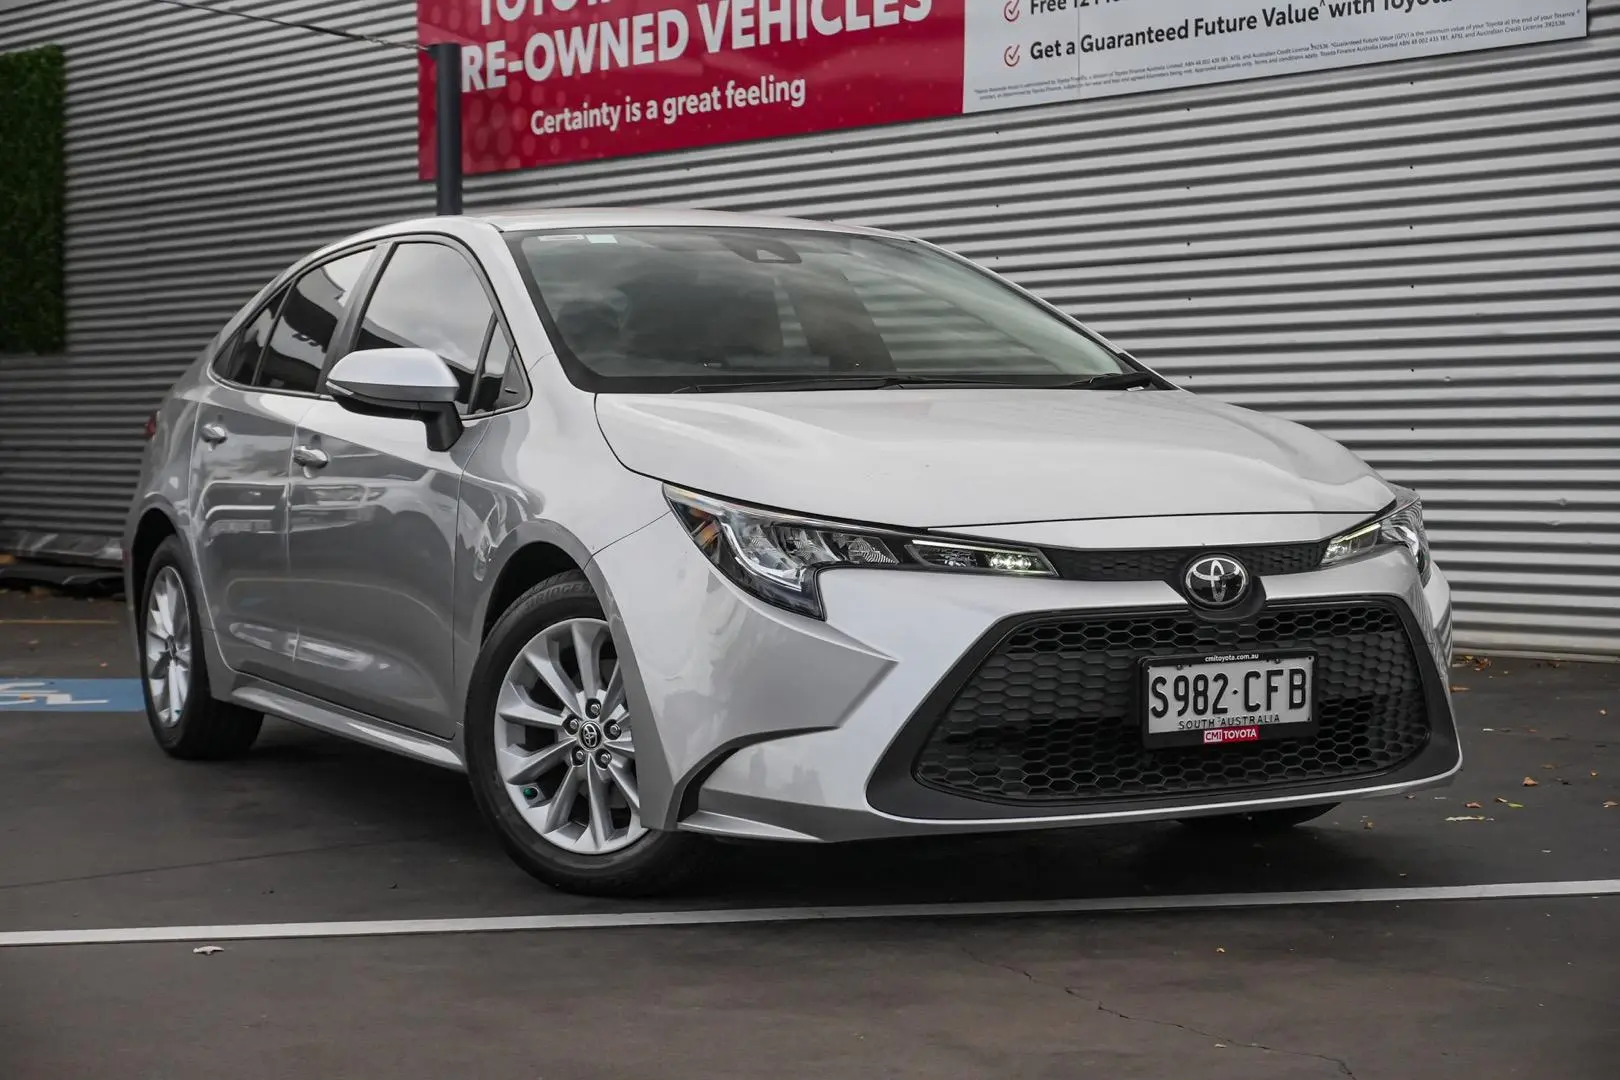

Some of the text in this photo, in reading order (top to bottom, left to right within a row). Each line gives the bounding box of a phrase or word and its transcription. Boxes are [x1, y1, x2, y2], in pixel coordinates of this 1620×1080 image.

[1030, 39, 1061, 60] Get
[1066, 41, 1076, 55] a
[1080, 18, 1189, 53] Guaranteed
[1194, 15, 1257, 37] Future
[1328, 0, 1375, 18] with
[461, 9, 689, 93] RE-OWNED
[530, 75, 805, 135] Certainty is a great feeling
[1204, 653, 1260, 663] cmitoyota.com.au
[1178, 714, 1281, 730] SOUTH AUSTRALIA
[1223, 728, 1257, 739] TOYOTA
